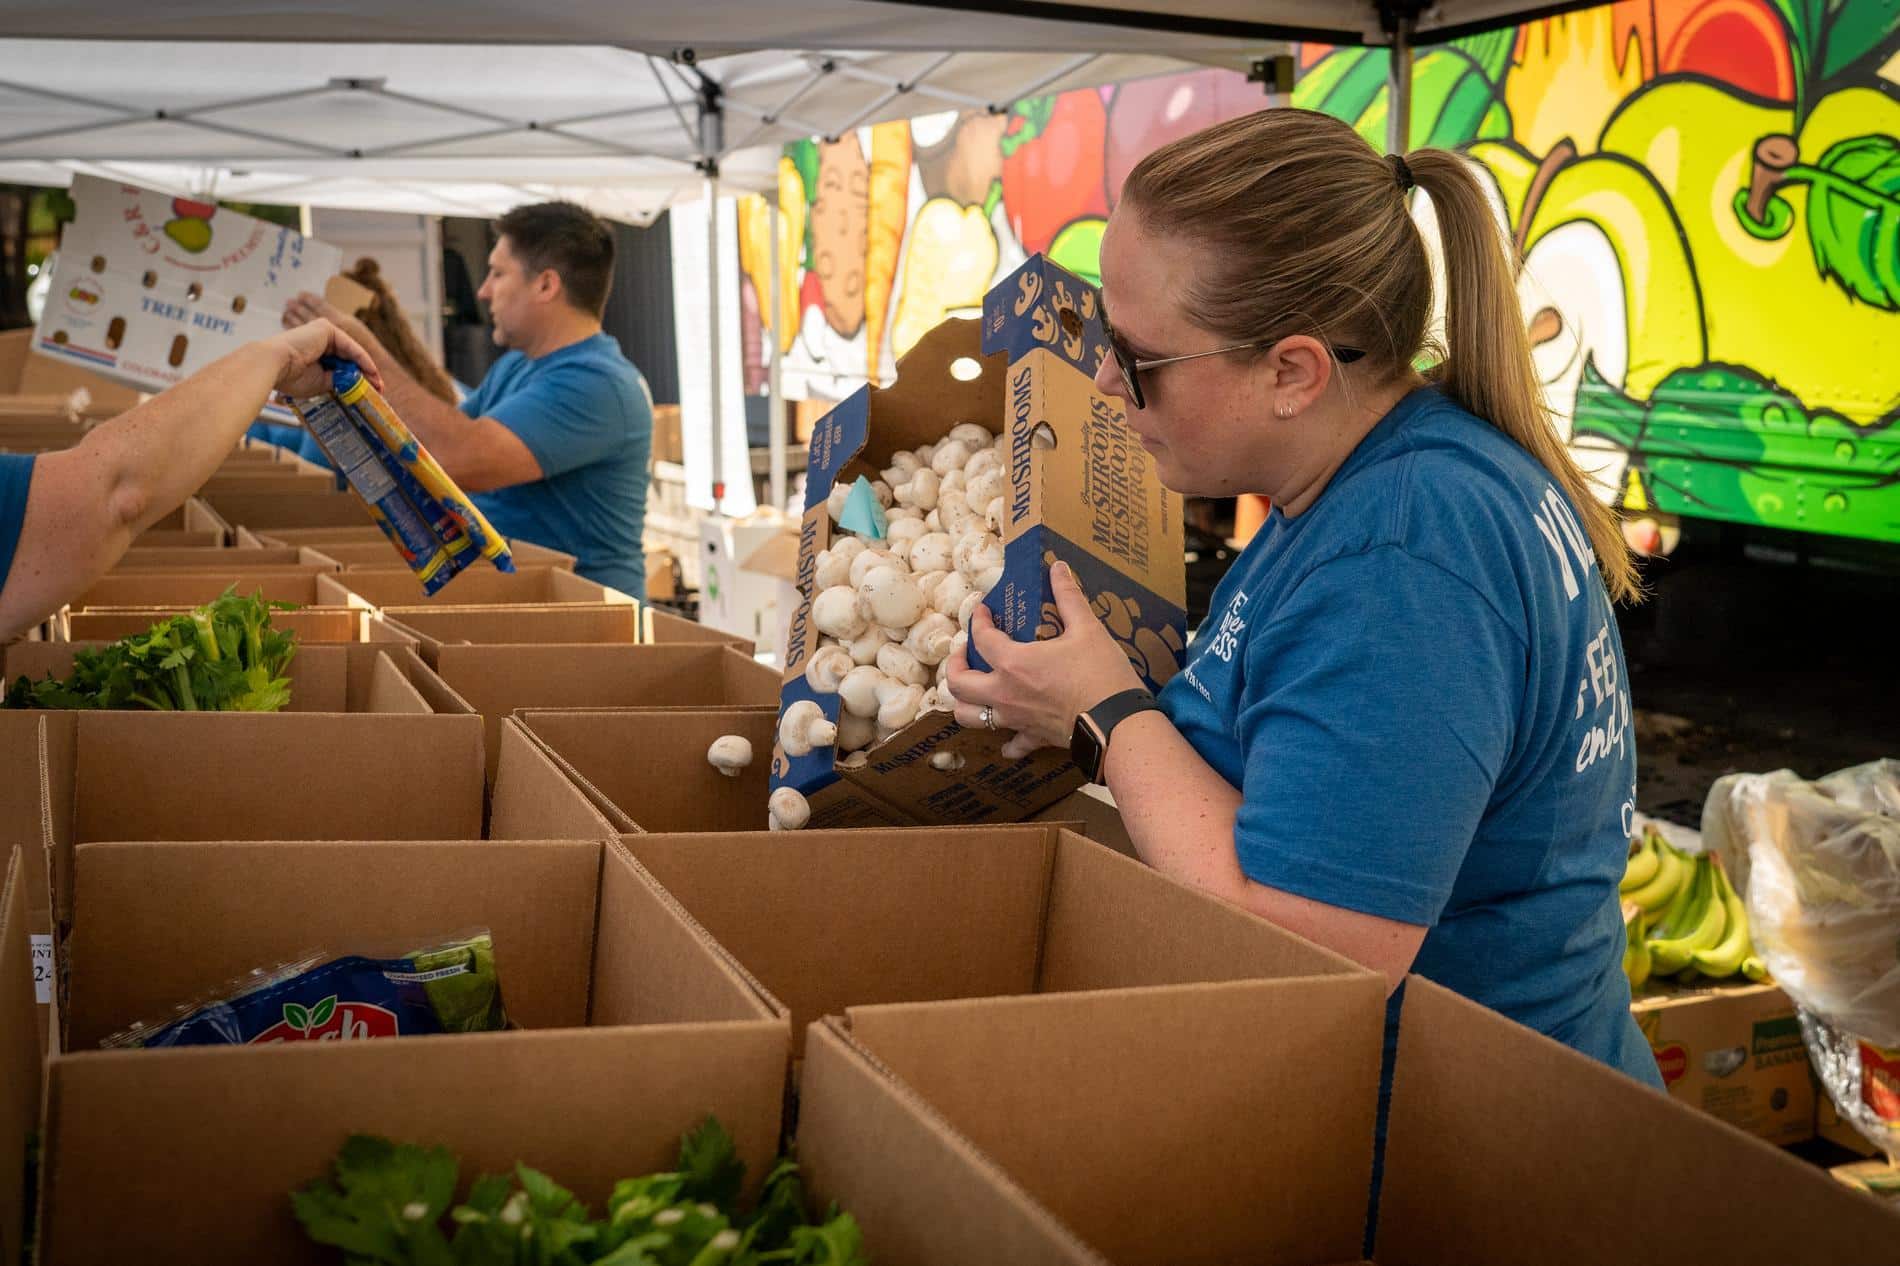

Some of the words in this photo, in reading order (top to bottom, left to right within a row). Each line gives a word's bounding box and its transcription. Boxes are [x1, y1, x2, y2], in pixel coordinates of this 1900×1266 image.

[141, 297, 188, 322] TREE
[192, 312, 236, 335] RIPE
[1012, 366, 1032, 525] MUSHROOMS
[1091, 396, 1112, 553] MUSHROOMS
[1110, 408, 1131, 565] MUSHROOMS
[1128, 429, 1150, 575] MUSHROOM
[871, 720, 961, 775] MUSHROOM
